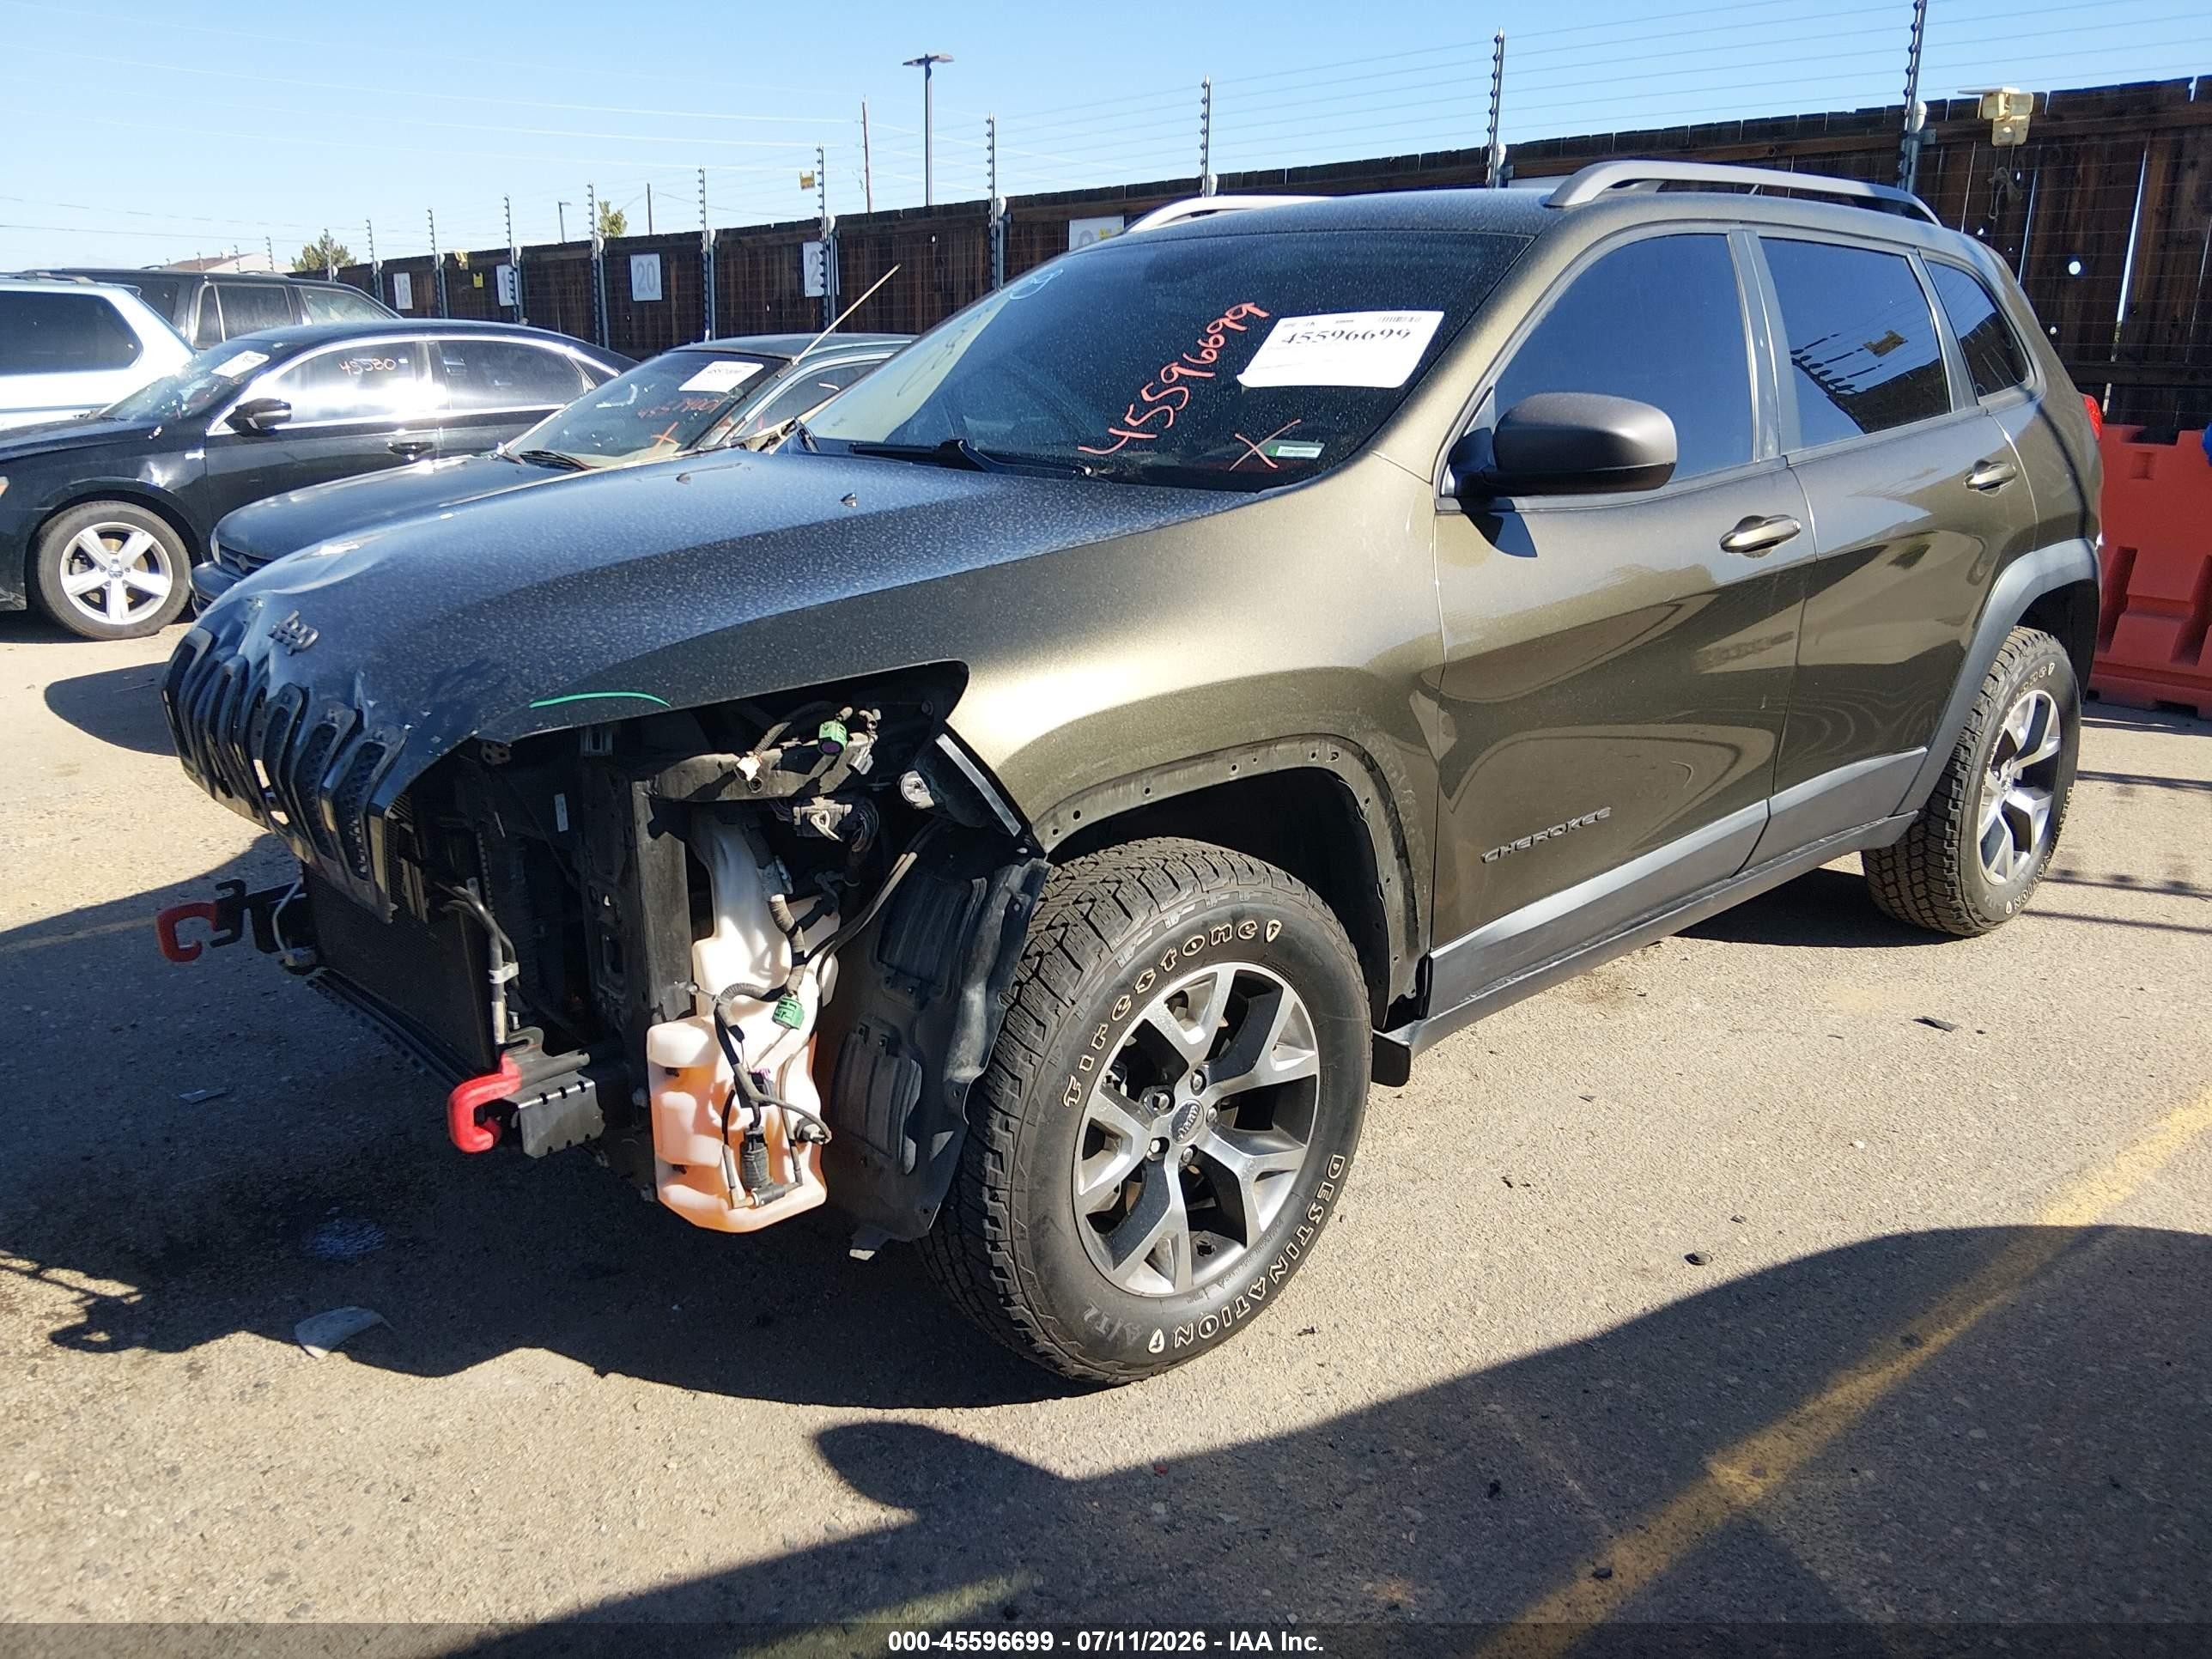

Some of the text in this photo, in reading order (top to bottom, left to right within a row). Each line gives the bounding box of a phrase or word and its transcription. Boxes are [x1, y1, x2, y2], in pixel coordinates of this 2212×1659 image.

[636, 260, 657, 293] 20
[1281, 328, 1412, 344] 45596699
[1078, 301, 1270, 455] 45596699
[1481, 807, 1611, 863] CHEROKEE
[1173, 1154, 1346, 1349] DESTINATION
